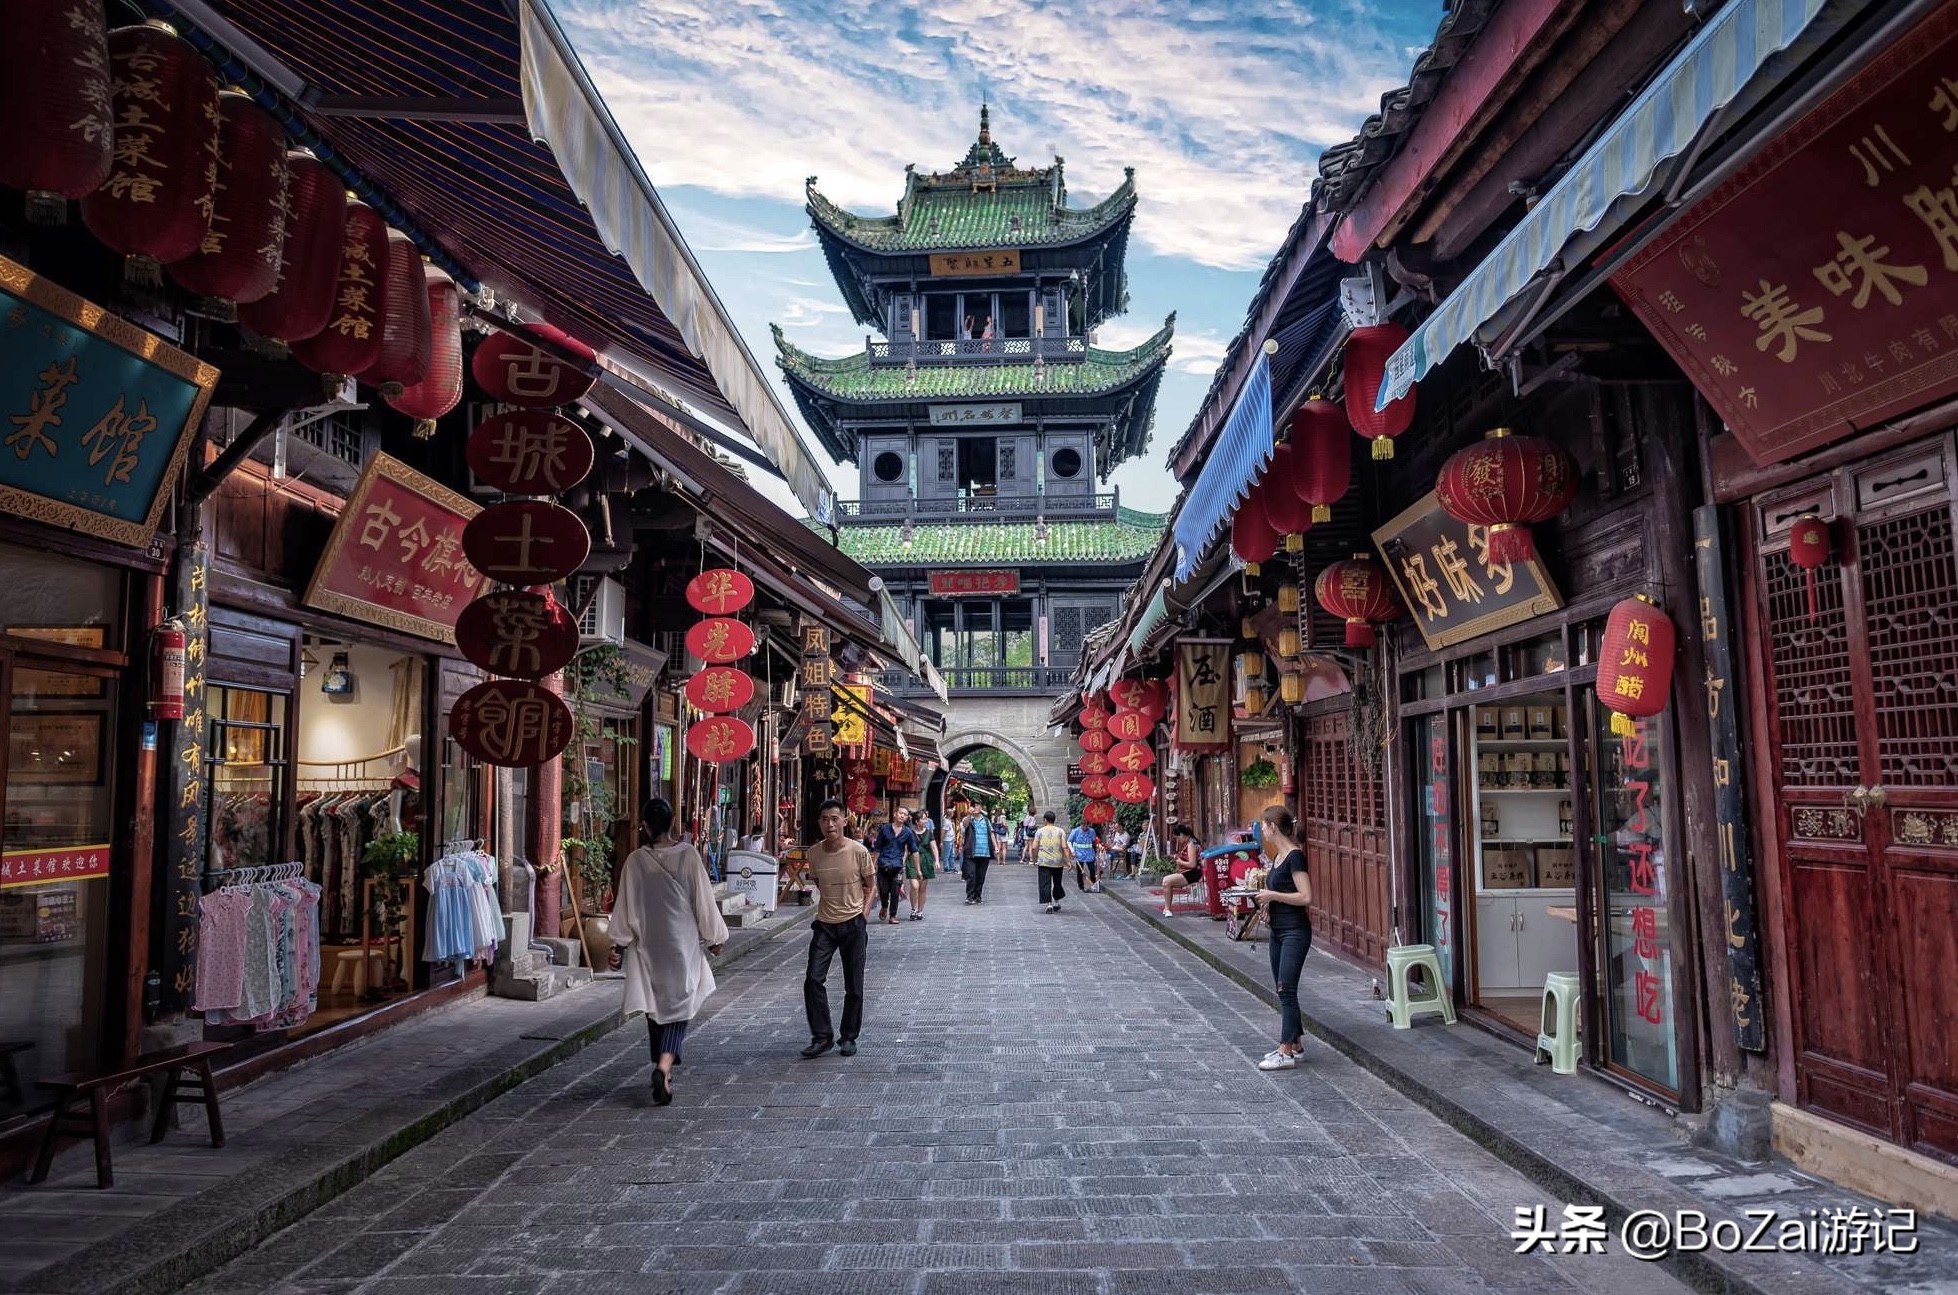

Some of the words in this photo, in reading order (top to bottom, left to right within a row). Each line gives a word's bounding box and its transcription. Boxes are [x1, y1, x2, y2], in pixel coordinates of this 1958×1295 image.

[100, 44, 170, 204] 古城土菜馆
[802, 628, 829, 752] 凤姐特色
